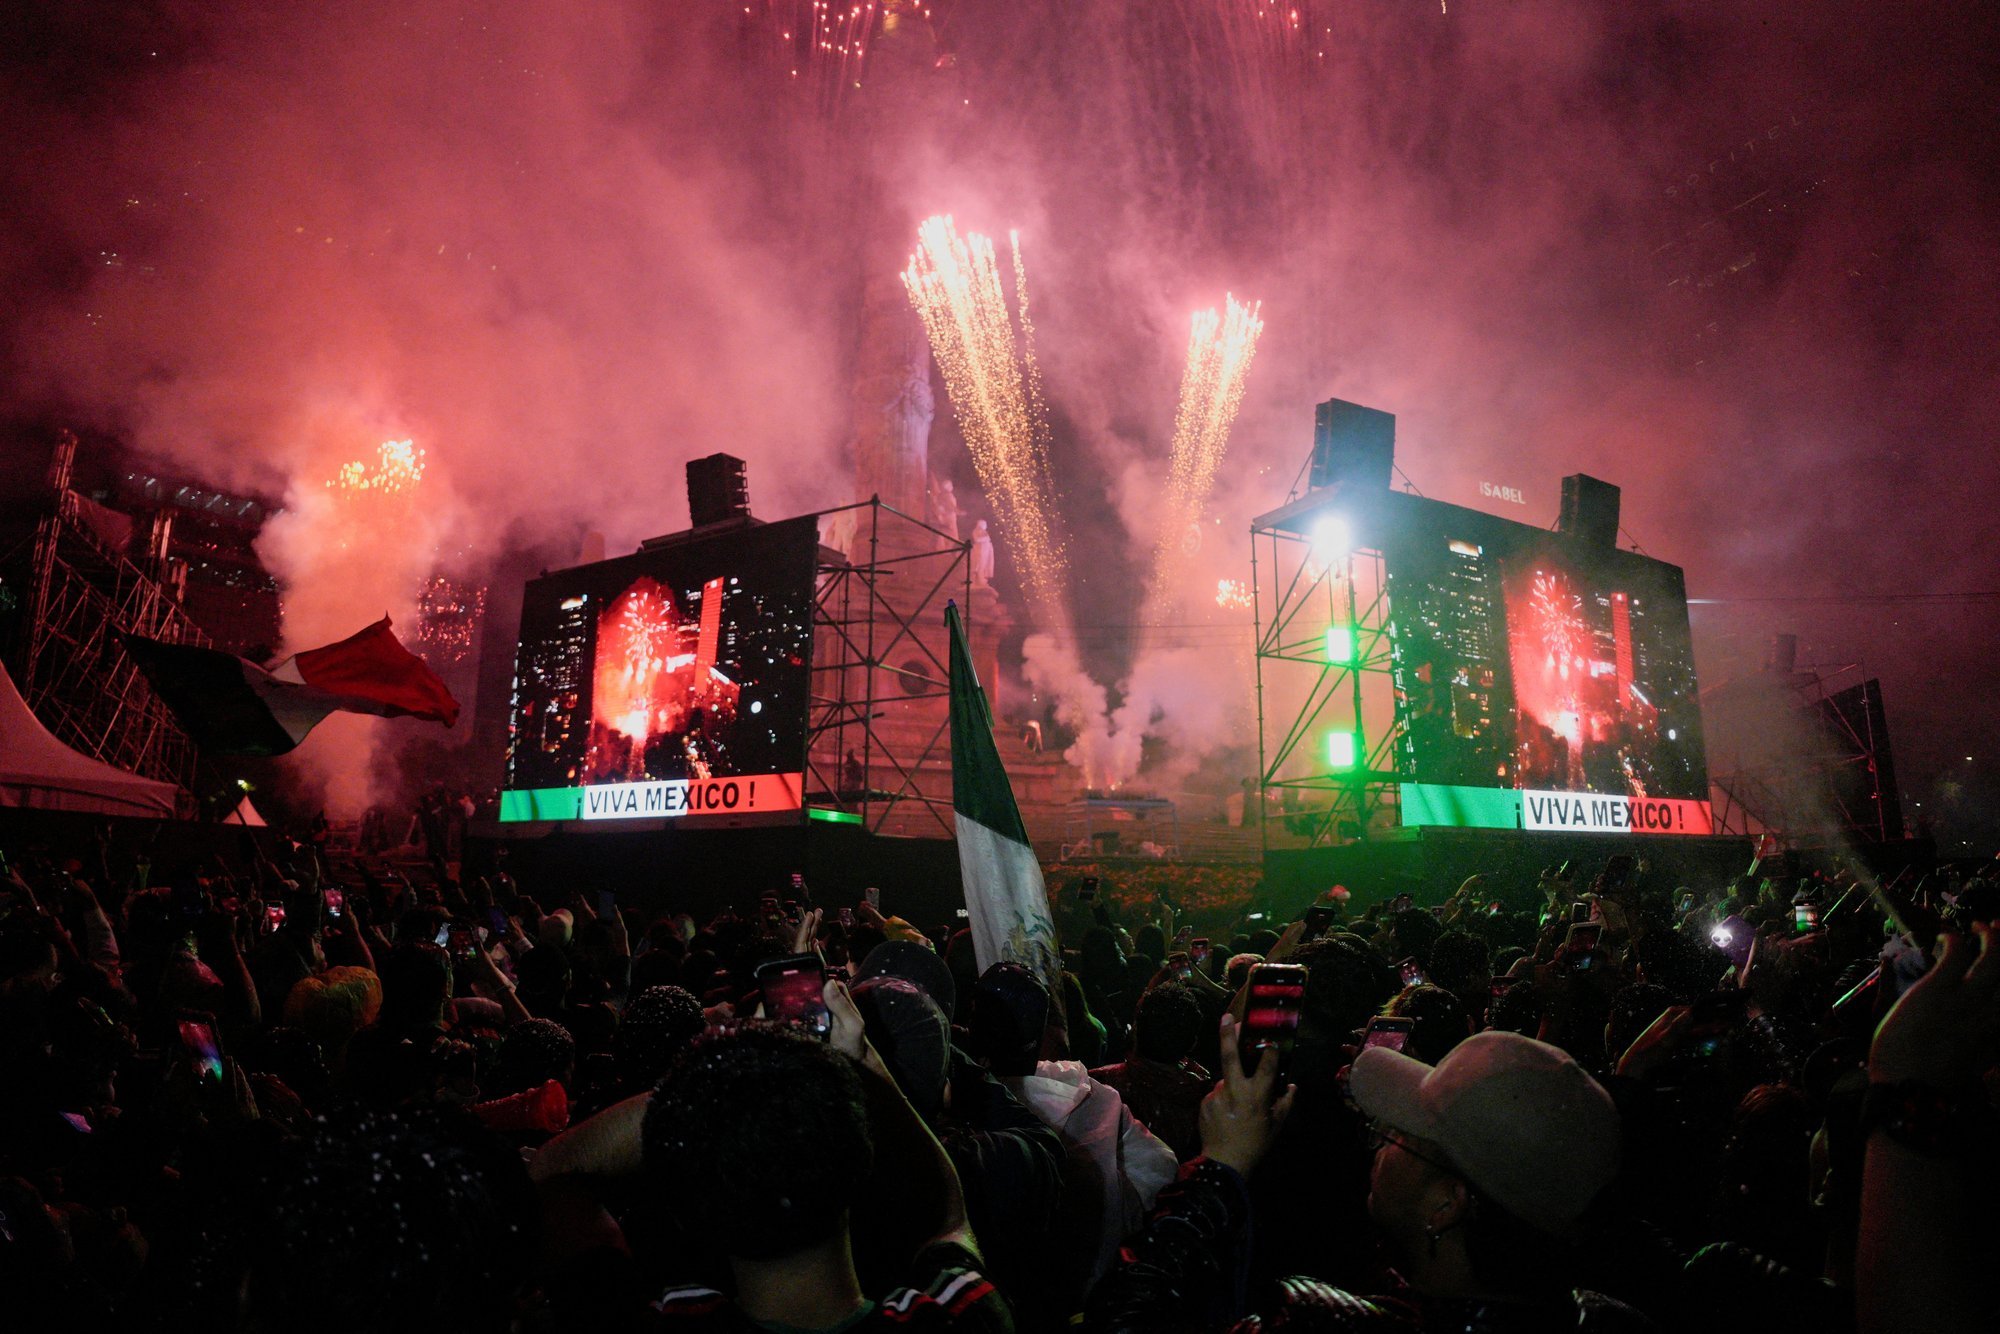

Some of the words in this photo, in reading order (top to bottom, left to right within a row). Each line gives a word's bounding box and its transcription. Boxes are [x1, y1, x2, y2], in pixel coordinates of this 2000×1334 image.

[1664, 115, 1801, 197] SOFITEL
[1479, 481, 1526, 504] ISABEL
[645, 781, 739, 811] MEXICO
[1591, 800, 1672, 830] MEXICO
